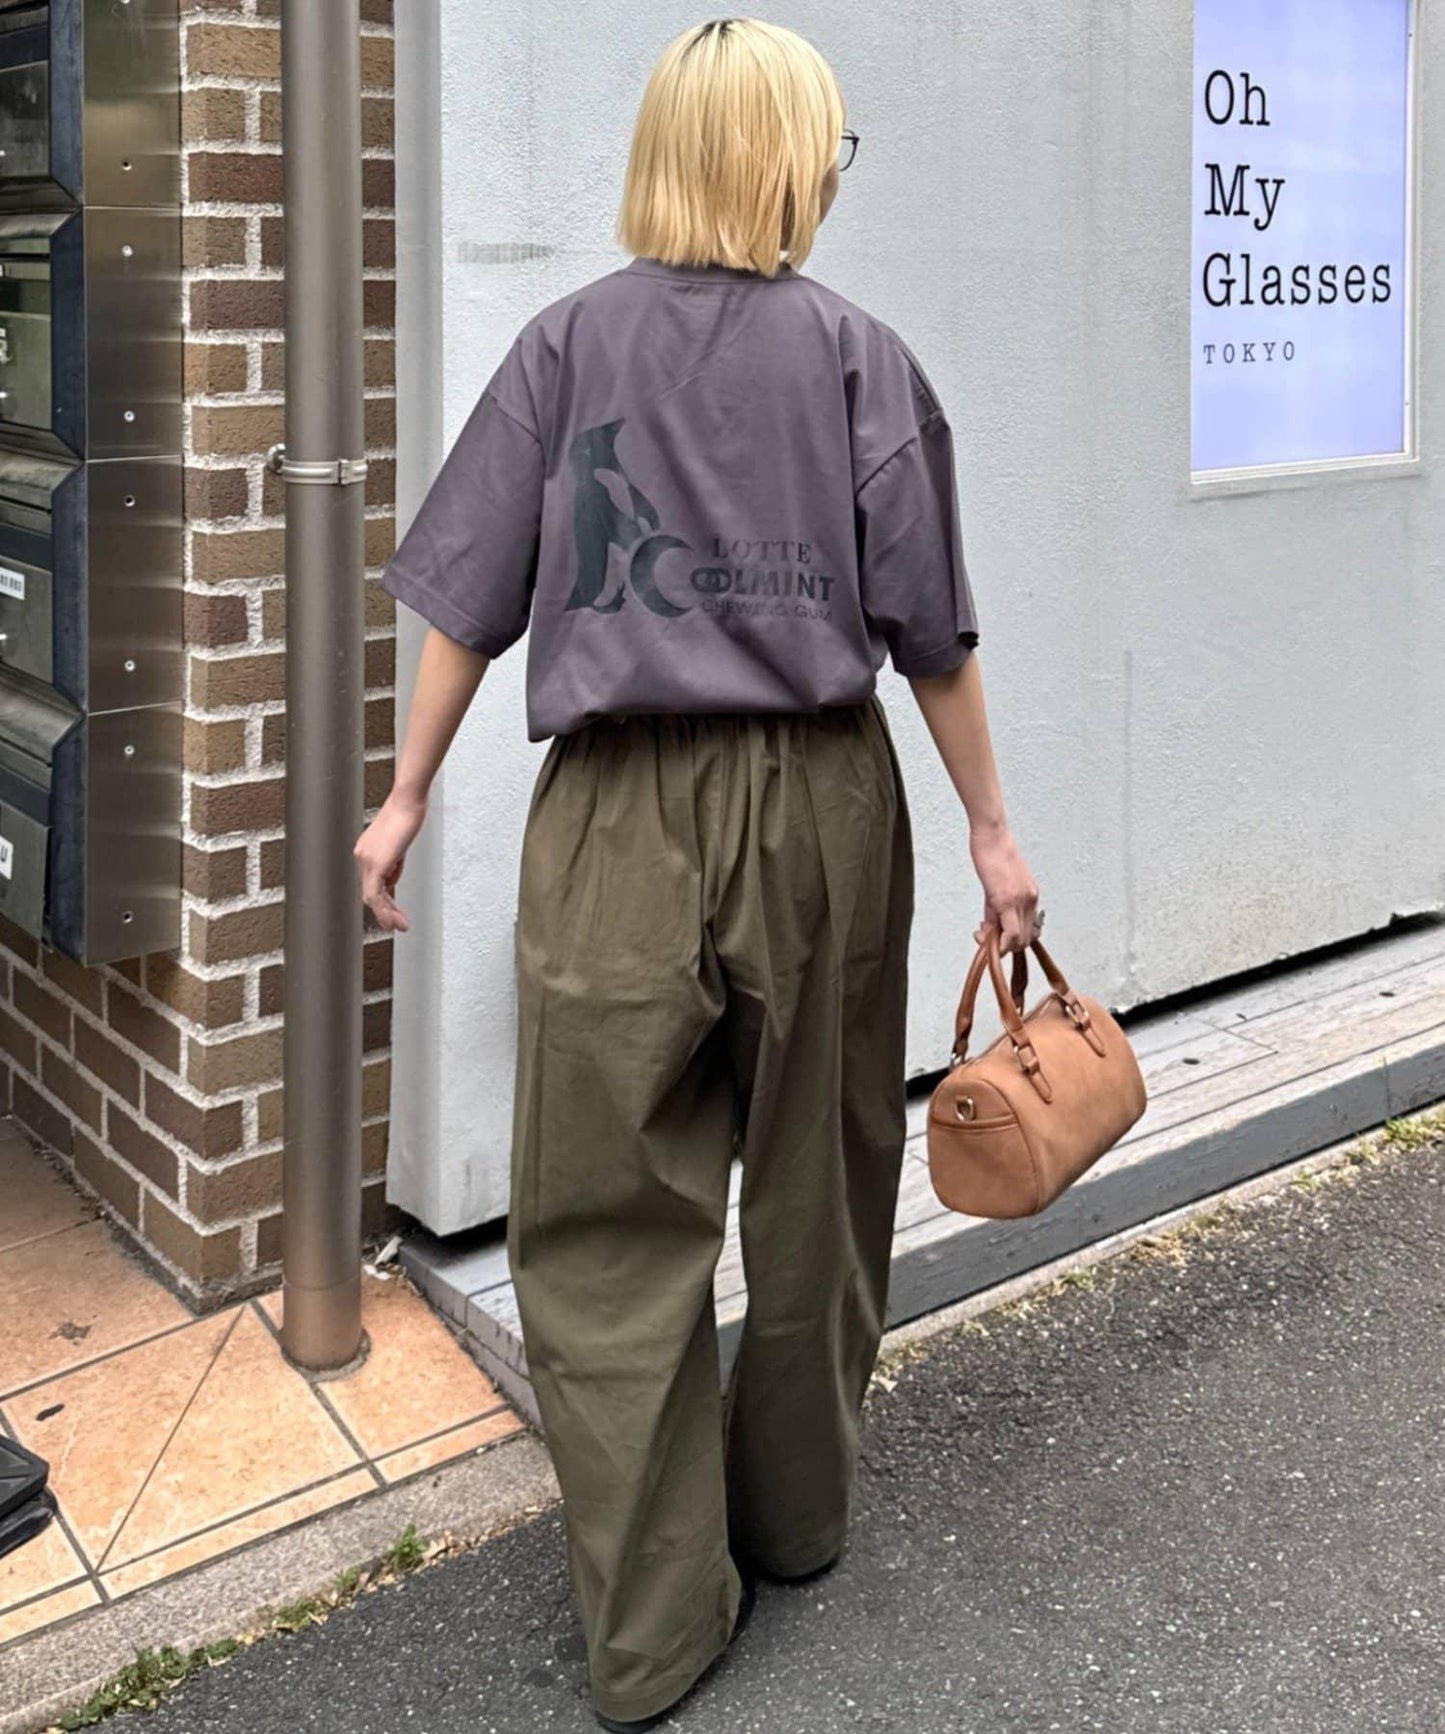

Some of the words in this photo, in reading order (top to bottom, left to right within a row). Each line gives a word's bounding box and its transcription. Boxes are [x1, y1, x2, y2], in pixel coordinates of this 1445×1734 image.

[1204, 69, 1271, 126] Oh
[1204, 163, 1285, 231] My
[1203, 252, 1392, 307] Glasses
[1204, 341, 1296, 364] TOKYO
[712, 537, 812, 565] LOTTE
